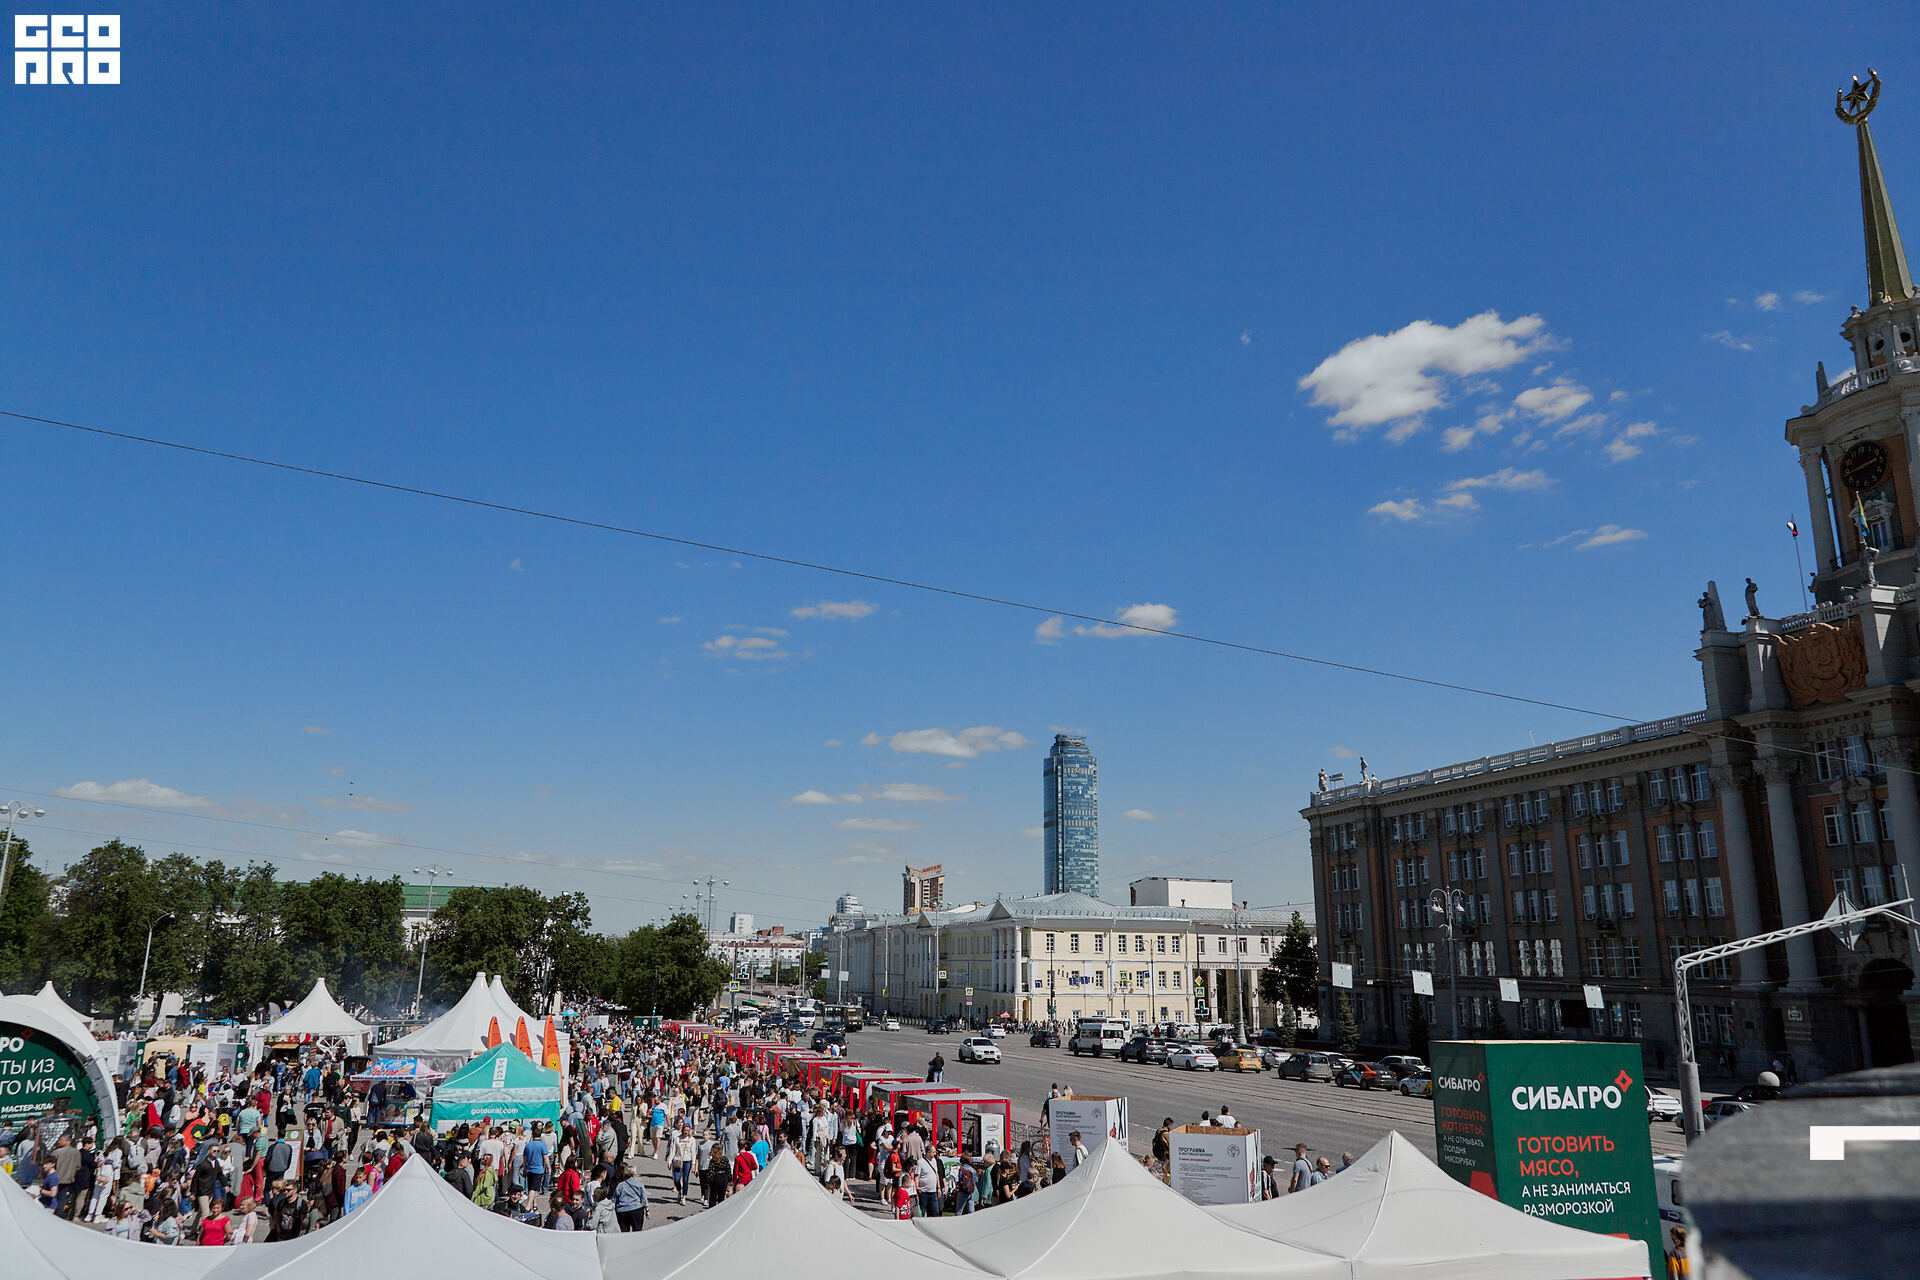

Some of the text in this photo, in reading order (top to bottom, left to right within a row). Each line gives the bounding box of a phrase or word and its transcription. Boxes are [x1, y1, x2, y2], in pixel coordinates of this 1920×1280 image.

[31, 1058, 55, 1074] ИЗ
[25, 1076, 76, 1094] МЯСА
[1438, 1076, 1480, 1092] СИБАГРО
[1511, 1085, 1622, 1111] СИБАГРО
[1, 1103, 54, 1112] МАСТЕР-КЛА
[470, 1107, 519, 1116] gotoural.com
[1441, 1106, 1486, 1122] ГОТОВИТЬ
[1442, 1120, 1485, 1136] КОТЛЕТЫ,
[1517, 1135, 1615, 1154] ГОТОВИТЬ
[1520, 1158, 1579, 1178] МЯСО,
[1521, 1181, 1631, 1198] А НЕ ЗАНИМАТЬСЯ
[1523, 1198, 1615, 1216] РАЗМОРОЗКОЙ
